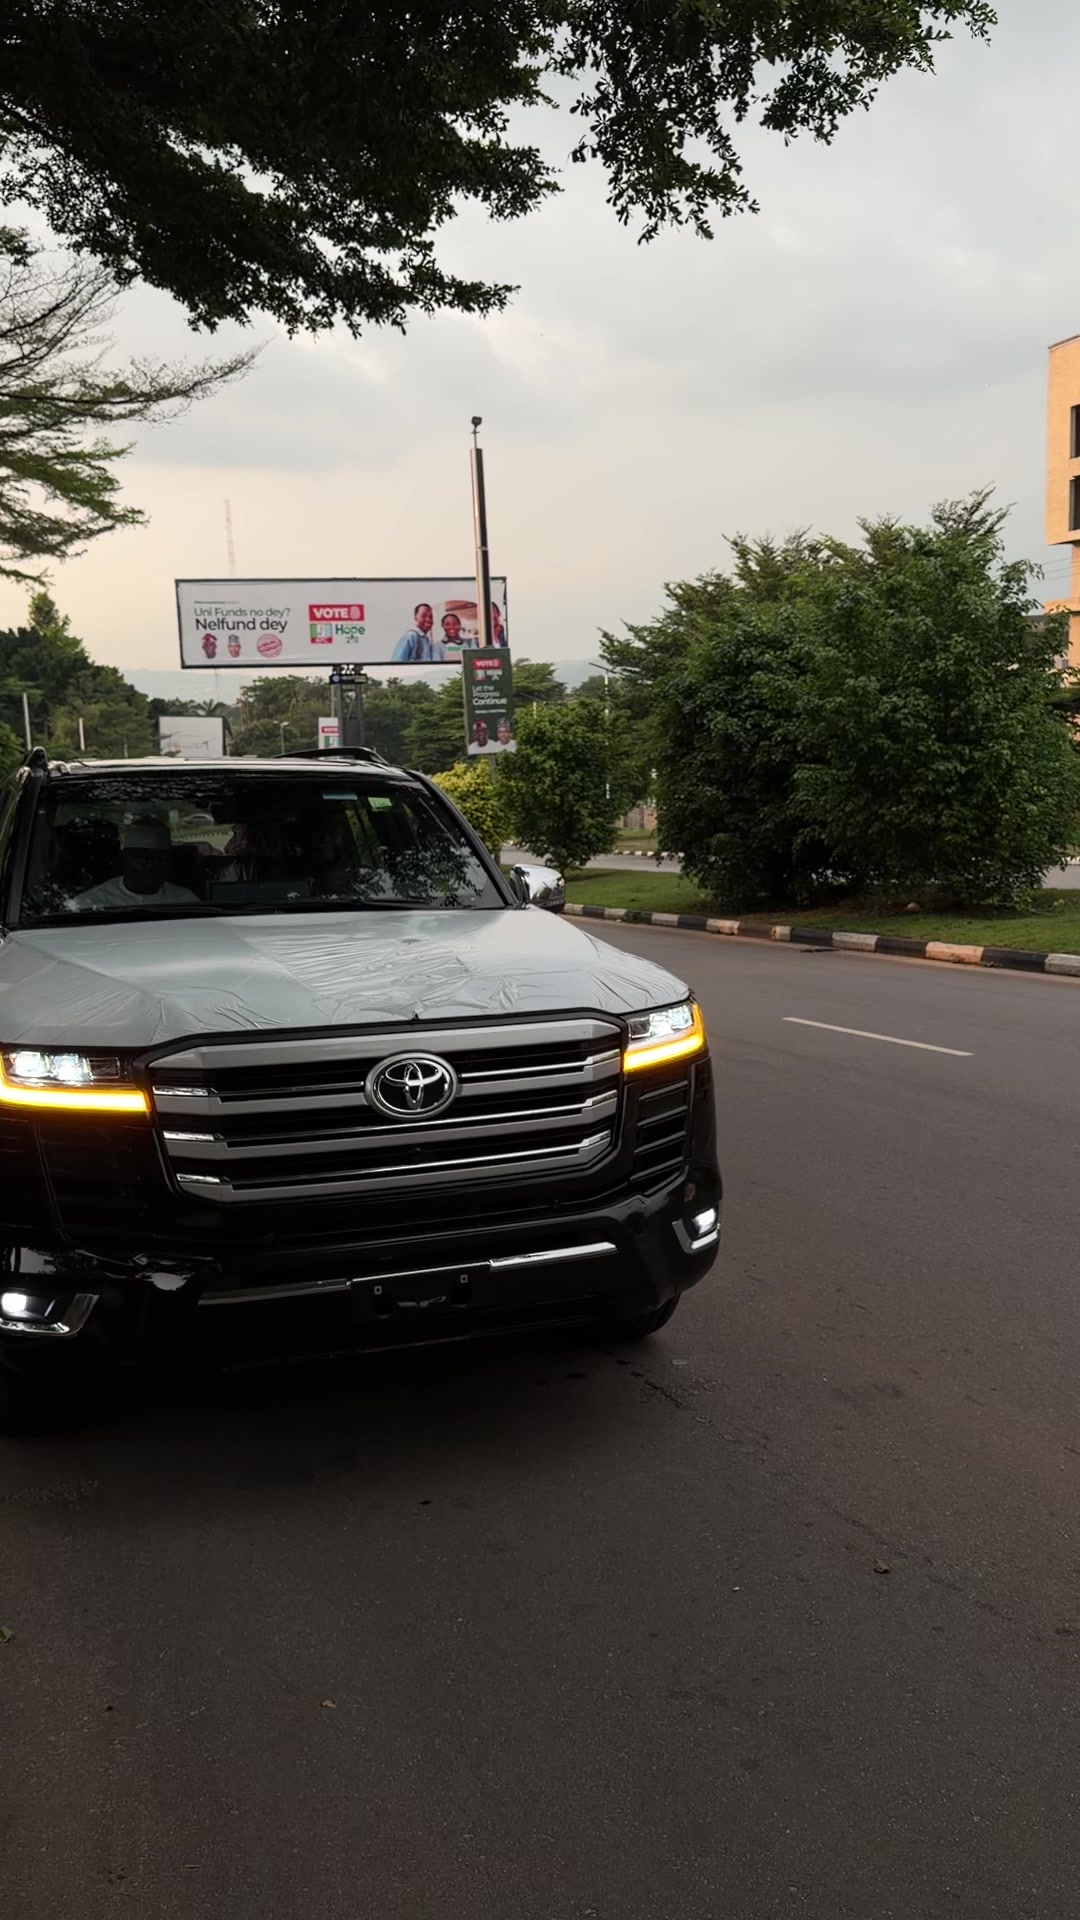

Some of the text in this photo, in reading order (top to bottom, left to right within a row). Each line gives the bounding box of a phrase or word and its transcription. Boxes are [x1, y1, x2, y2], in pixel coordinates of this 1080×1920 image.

[194, 607, 291, 618] Uni Funds no dey?
[312, 608, 349, 619] VOTE
[195, 618, 288, 633] Nelfund dey
[335, 624, 366, 638] Hope
[472, 698, 508, 706] Continue
